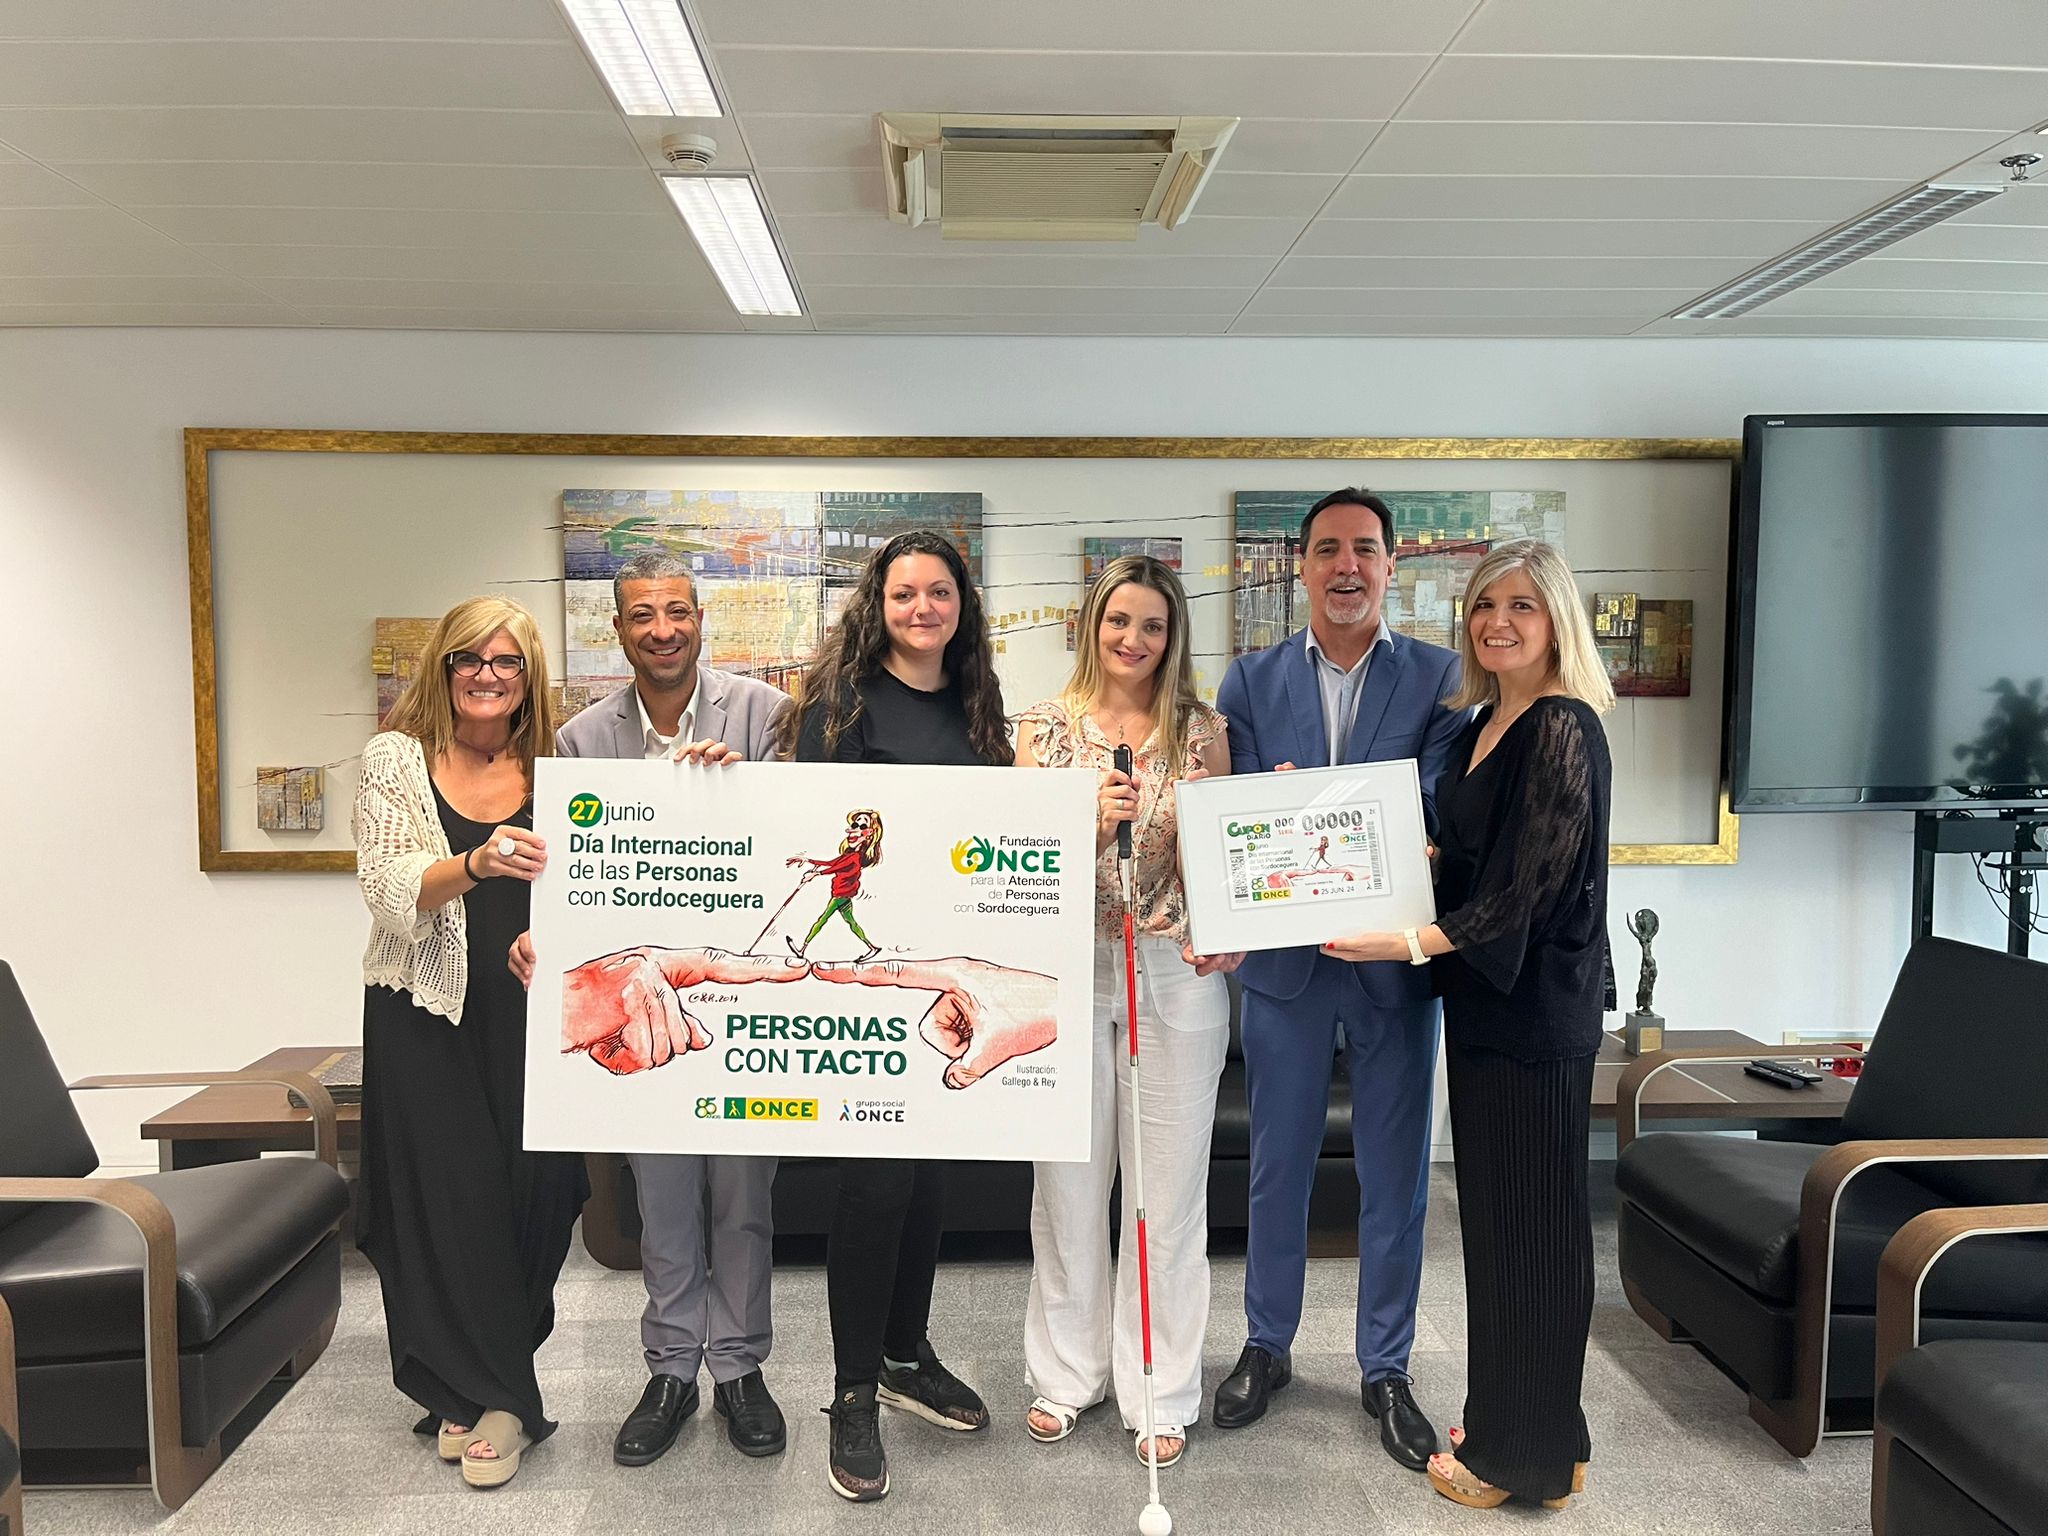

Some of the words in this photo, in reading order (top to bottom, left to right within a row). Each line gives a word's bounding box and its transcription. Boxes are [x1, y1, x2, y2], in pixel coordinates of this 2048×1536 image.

[571, 800, 599, 820] 27
[603, 801, 655, 826] junio
[1274, 817, 1295, 828] 000
[1302, 810, 1363, 831] 00000
[570, 833, 603, 853] Día
[611, 834, 752, 856] Internacional
[1000, 836, 1061, 847] Fundación
[569, 859, 594, 879] de
[600, 859, 629, 880] las
[636, 861, 737, 882] Personas
[971, 876, 994, 886] para
[997, 875, 1005, 885] la
[1008, 875, 1060, 886] Atención
[1251, 877, 1264, 890] 85
[568, 890, 606, 906] con
[612, 886, 764, 913] Sordoceguera
[988, 889, 1002, 899] de
[1006, 889, 1060, 900] Personas
[1263, 890, 1289, 899] ONCE
[954, 904, 974, 913] con
[977, 903, 1060, 916] Sordoceguera
[726, 1014, 907, 1042] PERSONAS
[725, 1048, 788, 1073] CON
[796, 1049, 907, 1075] TACTO
[1001, 1076, 1031, 1088] Gallego
[1033, 1077, 1039, 1087] &
[1041, 1077, 1056, 1088] Rey
[695, 1097, 717, 1118] 85
[751, 1101, 813, 1117] ONCE
[856, 1100, 881, 1108] grupo
[882, 1099, 906, 1108] social
[855, 1109, 905, 1122] ONCE
